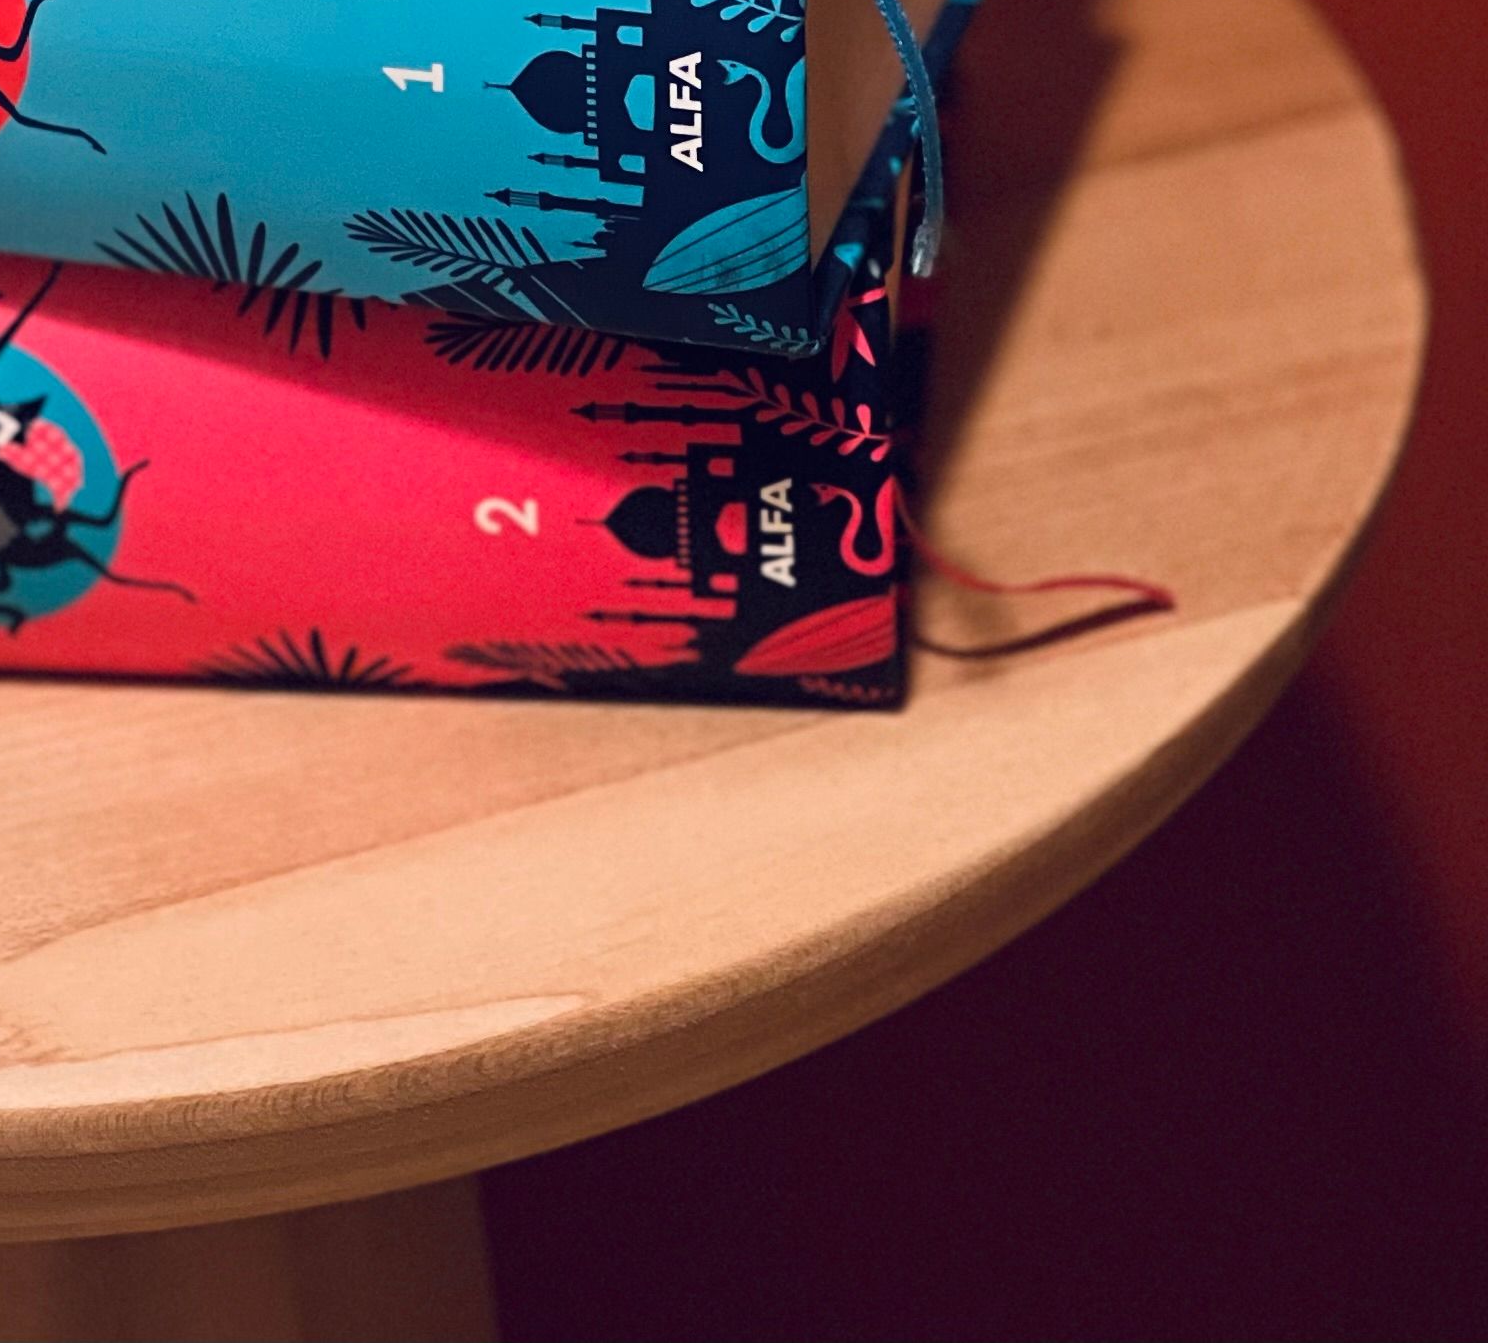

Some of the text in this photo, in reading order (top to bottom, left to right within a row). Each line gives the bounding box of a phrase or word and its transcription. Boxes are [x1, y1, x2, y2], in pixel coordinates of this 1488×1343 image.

[382, 62, 445, 92] 1
[668, 51, 704, 172] ALFA
[474, 497, 540, 537] 2
[759, 477, 797, 588] ALFA
